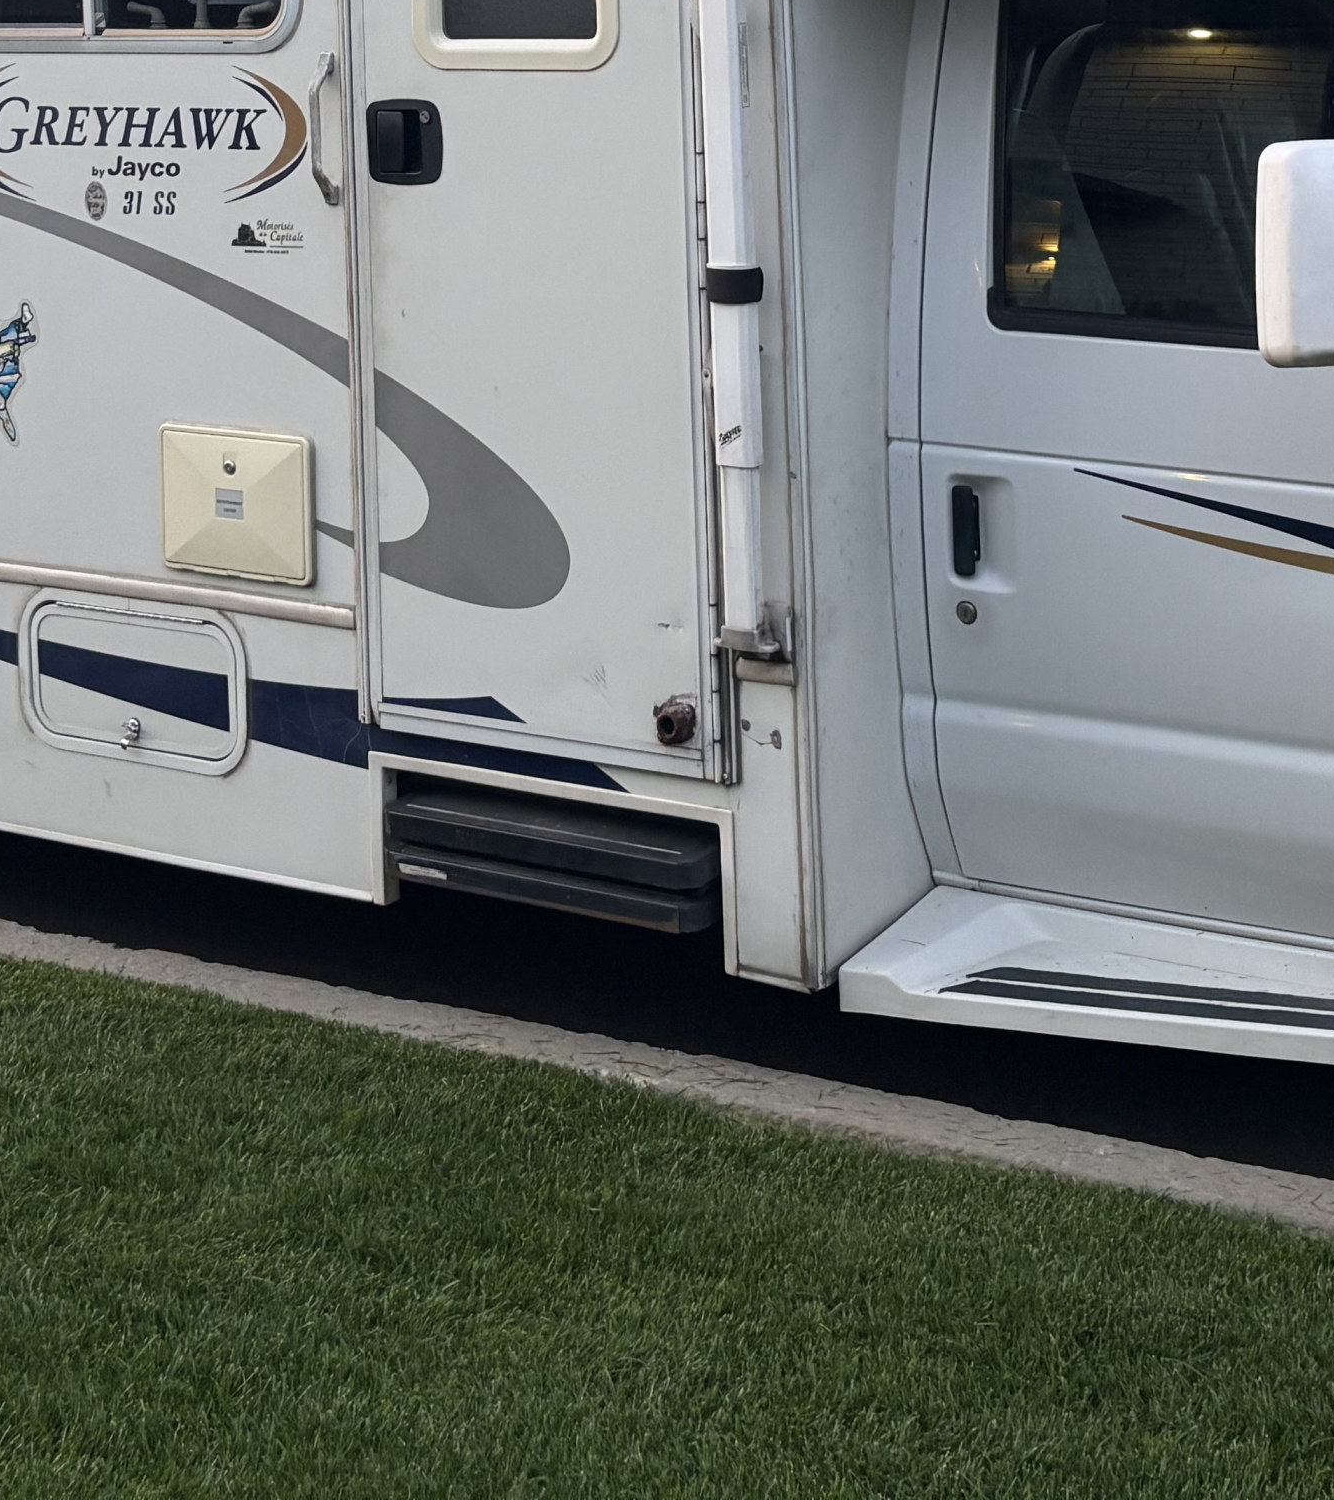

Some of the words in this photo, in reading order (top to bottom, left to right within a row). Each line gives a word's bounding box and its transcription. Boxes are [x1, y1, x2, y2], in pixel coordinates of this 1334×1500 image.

[91, 166, 105, 179] by
[107, 155, 181, 181] Jayco
[123, 190, 143, 215] 31
[153, 190, 177, 215] SS
